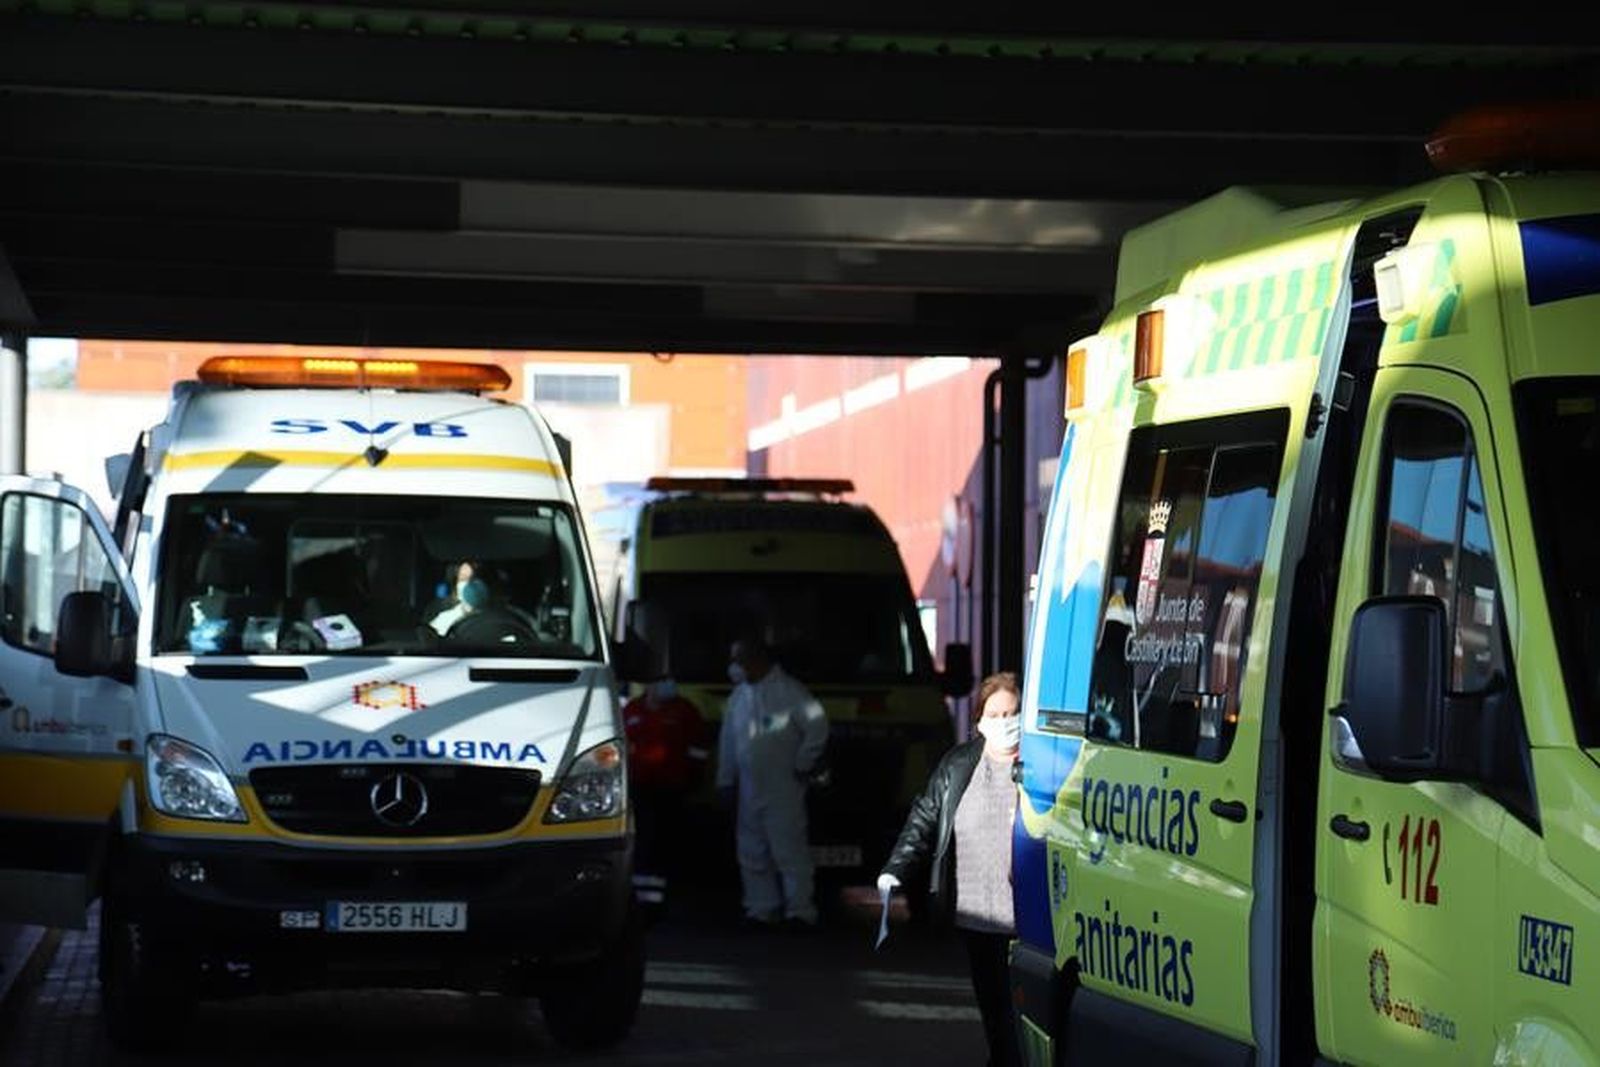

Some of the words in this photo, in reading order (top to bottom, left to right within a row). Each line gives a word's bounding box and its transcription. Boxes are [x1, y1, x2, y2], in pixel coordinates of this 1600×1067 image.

[270, 419, 468, 437] SVB
[1156, 593, 1188, 621] Junta
[1188, 593, 1204, 621] de
[1125, 632, 1160, 662] Castilla
[1398, 814, 1440, 905] 112
[284, 911, 317, 928] SP
[343, 906, 402, 928] 2556
[410, 906, 458, 928] HLJ
[1521, 918, 1572, 981] U-3347
